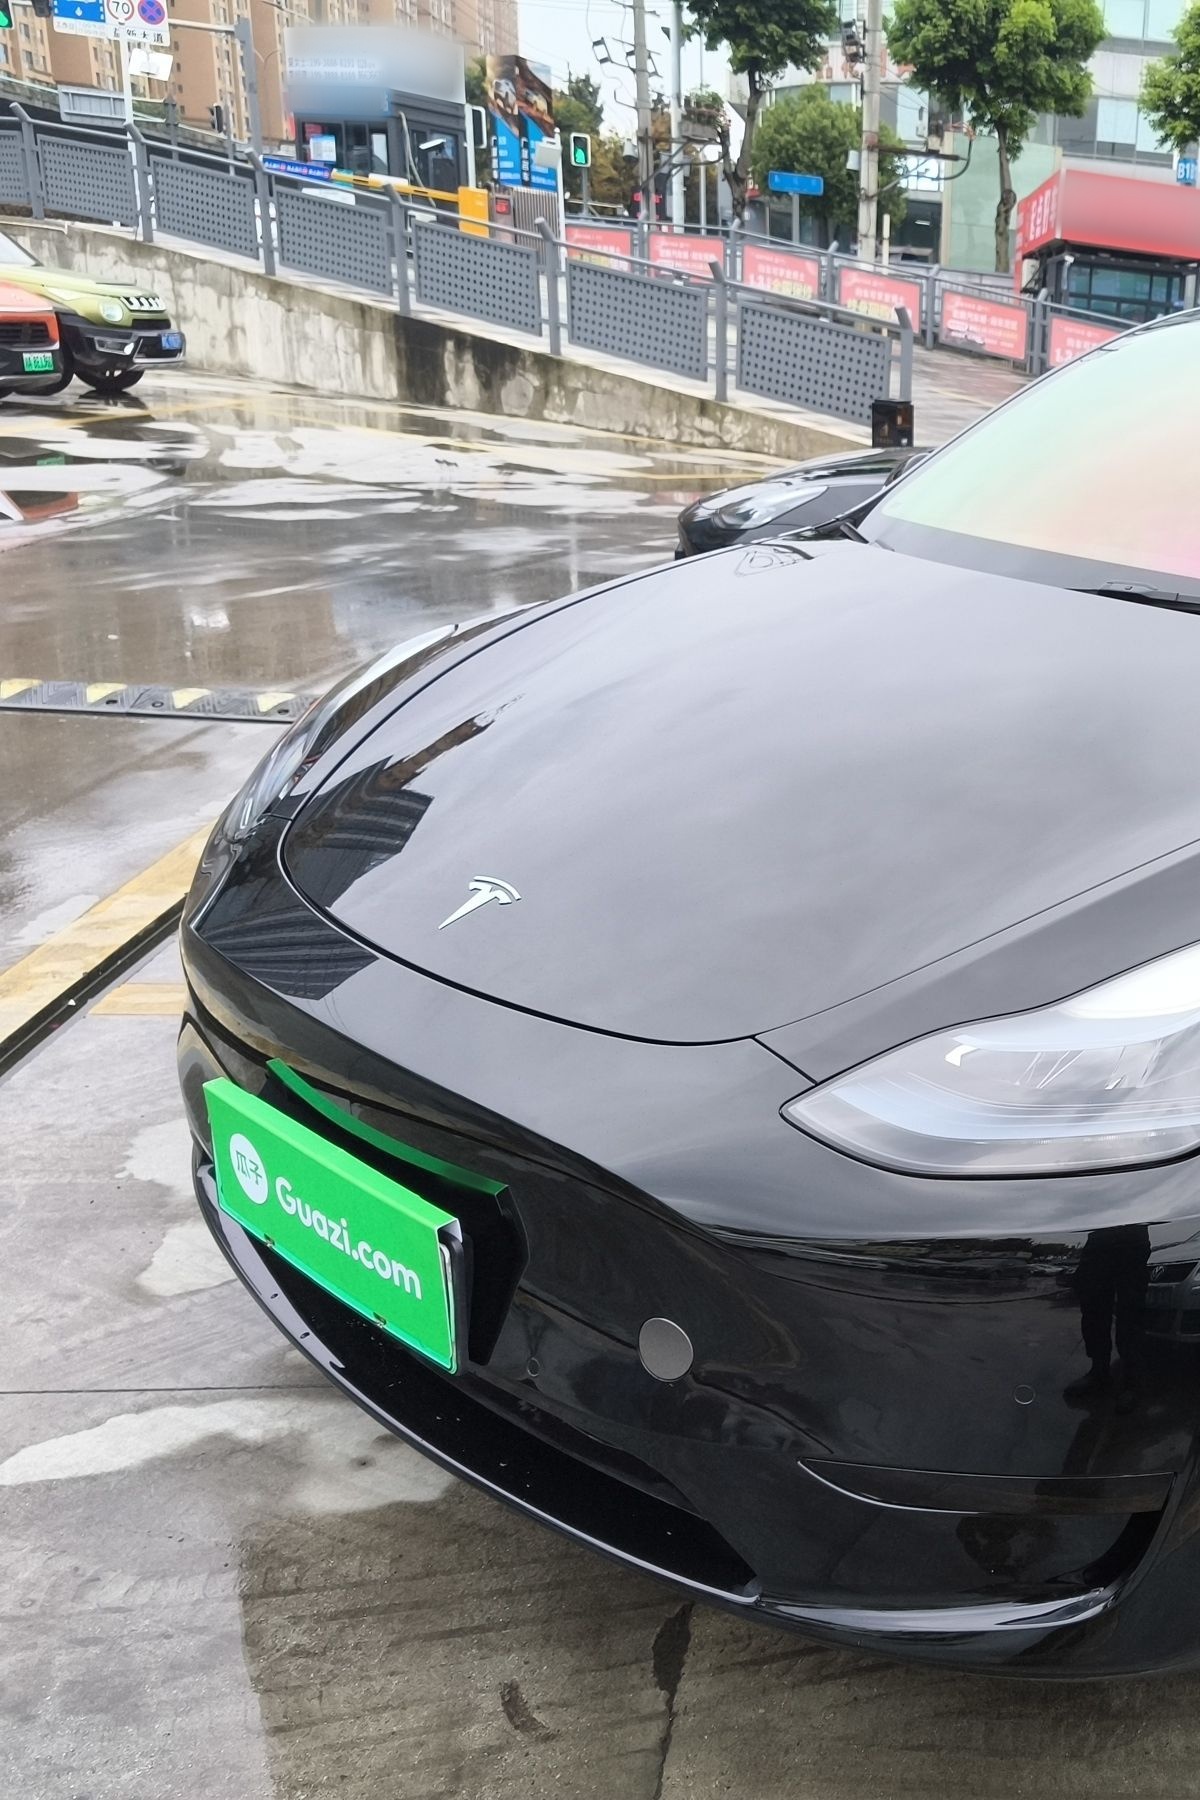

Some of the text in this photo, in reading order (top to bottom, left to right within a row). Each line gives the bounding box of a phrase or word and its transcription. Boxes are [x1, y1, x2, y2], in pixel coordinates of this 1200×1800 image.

[112, 1, 130, 15] 70
[234, 1149, 263, 1186] 瓜子
[275, 1175, 423, 1301] Guazi.com
